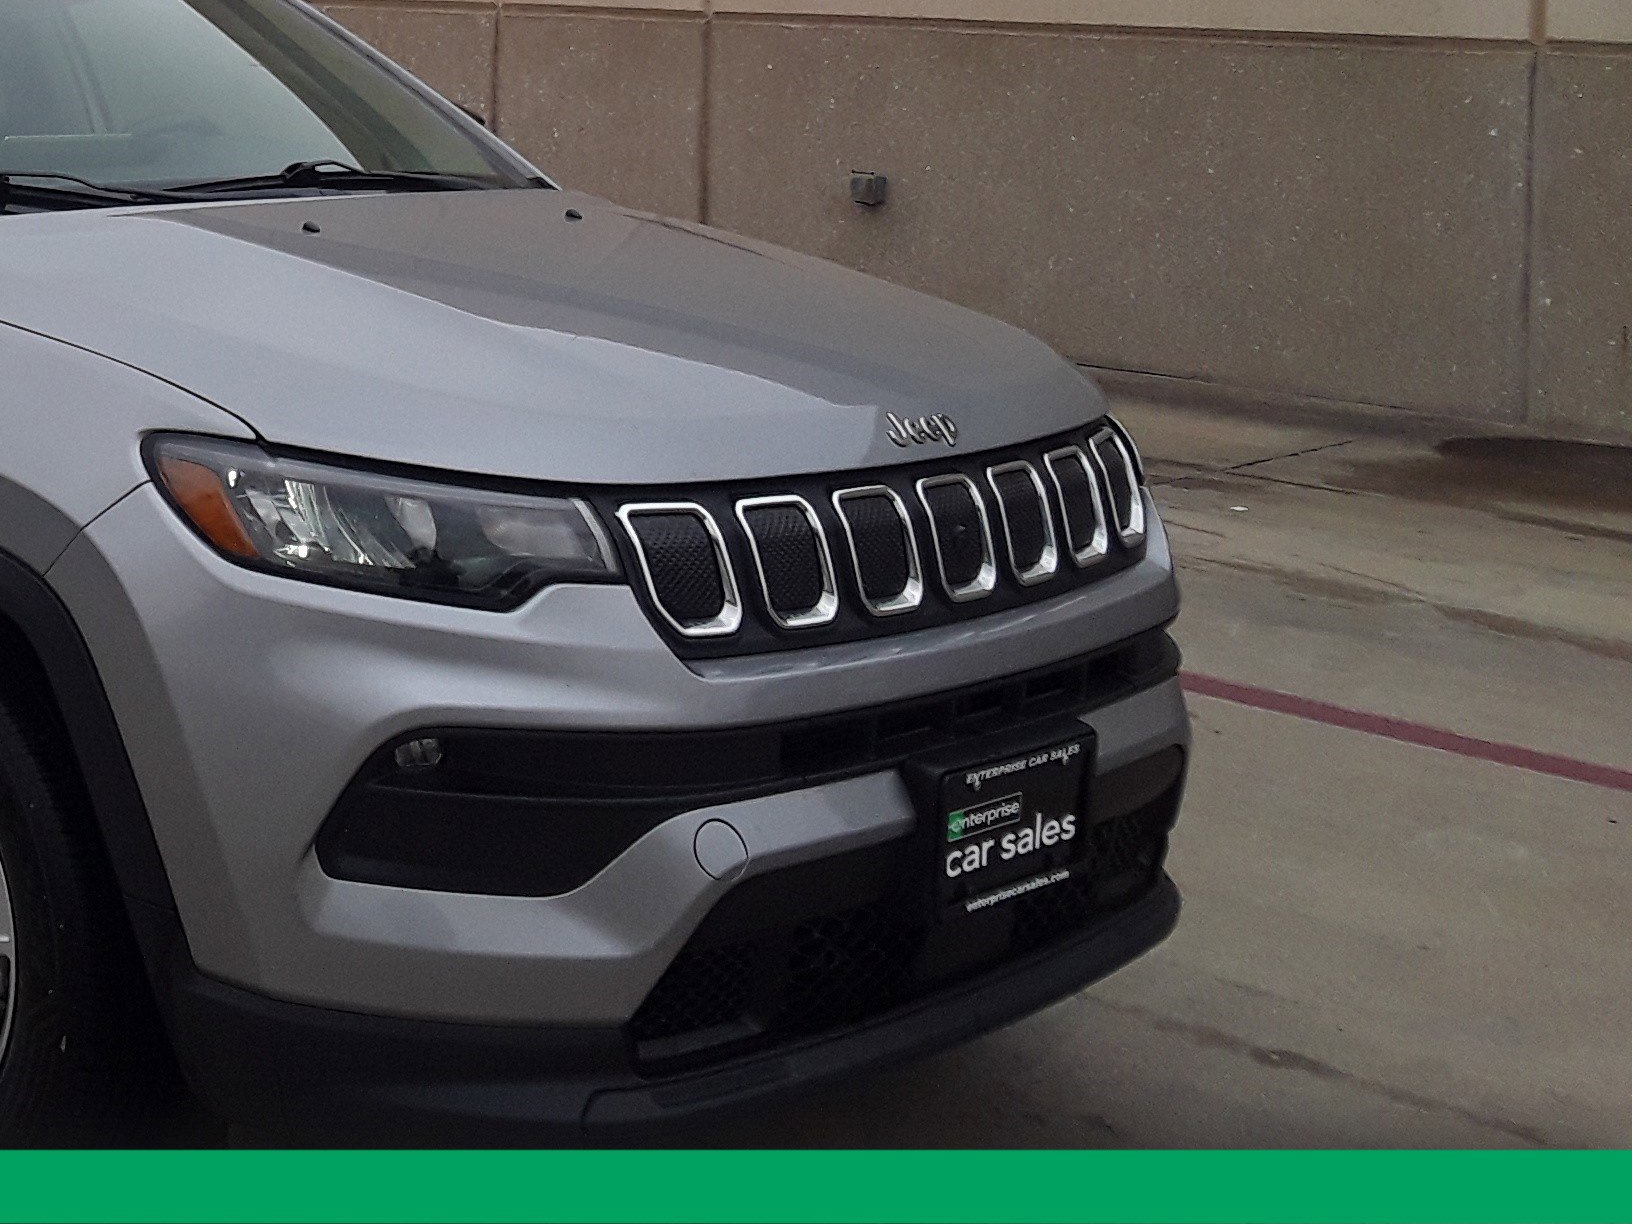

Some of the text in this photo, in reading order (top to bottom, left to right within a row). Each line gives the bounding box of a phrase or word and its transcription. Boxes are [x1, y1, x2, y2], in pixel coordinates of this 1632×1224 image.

[885, 411, 958, 448] Jeep
[1028, 753, 1049, 768] CAR
[949, 801, 1020, 834] enterprise
[945, 812, 1077, 878] car sales
